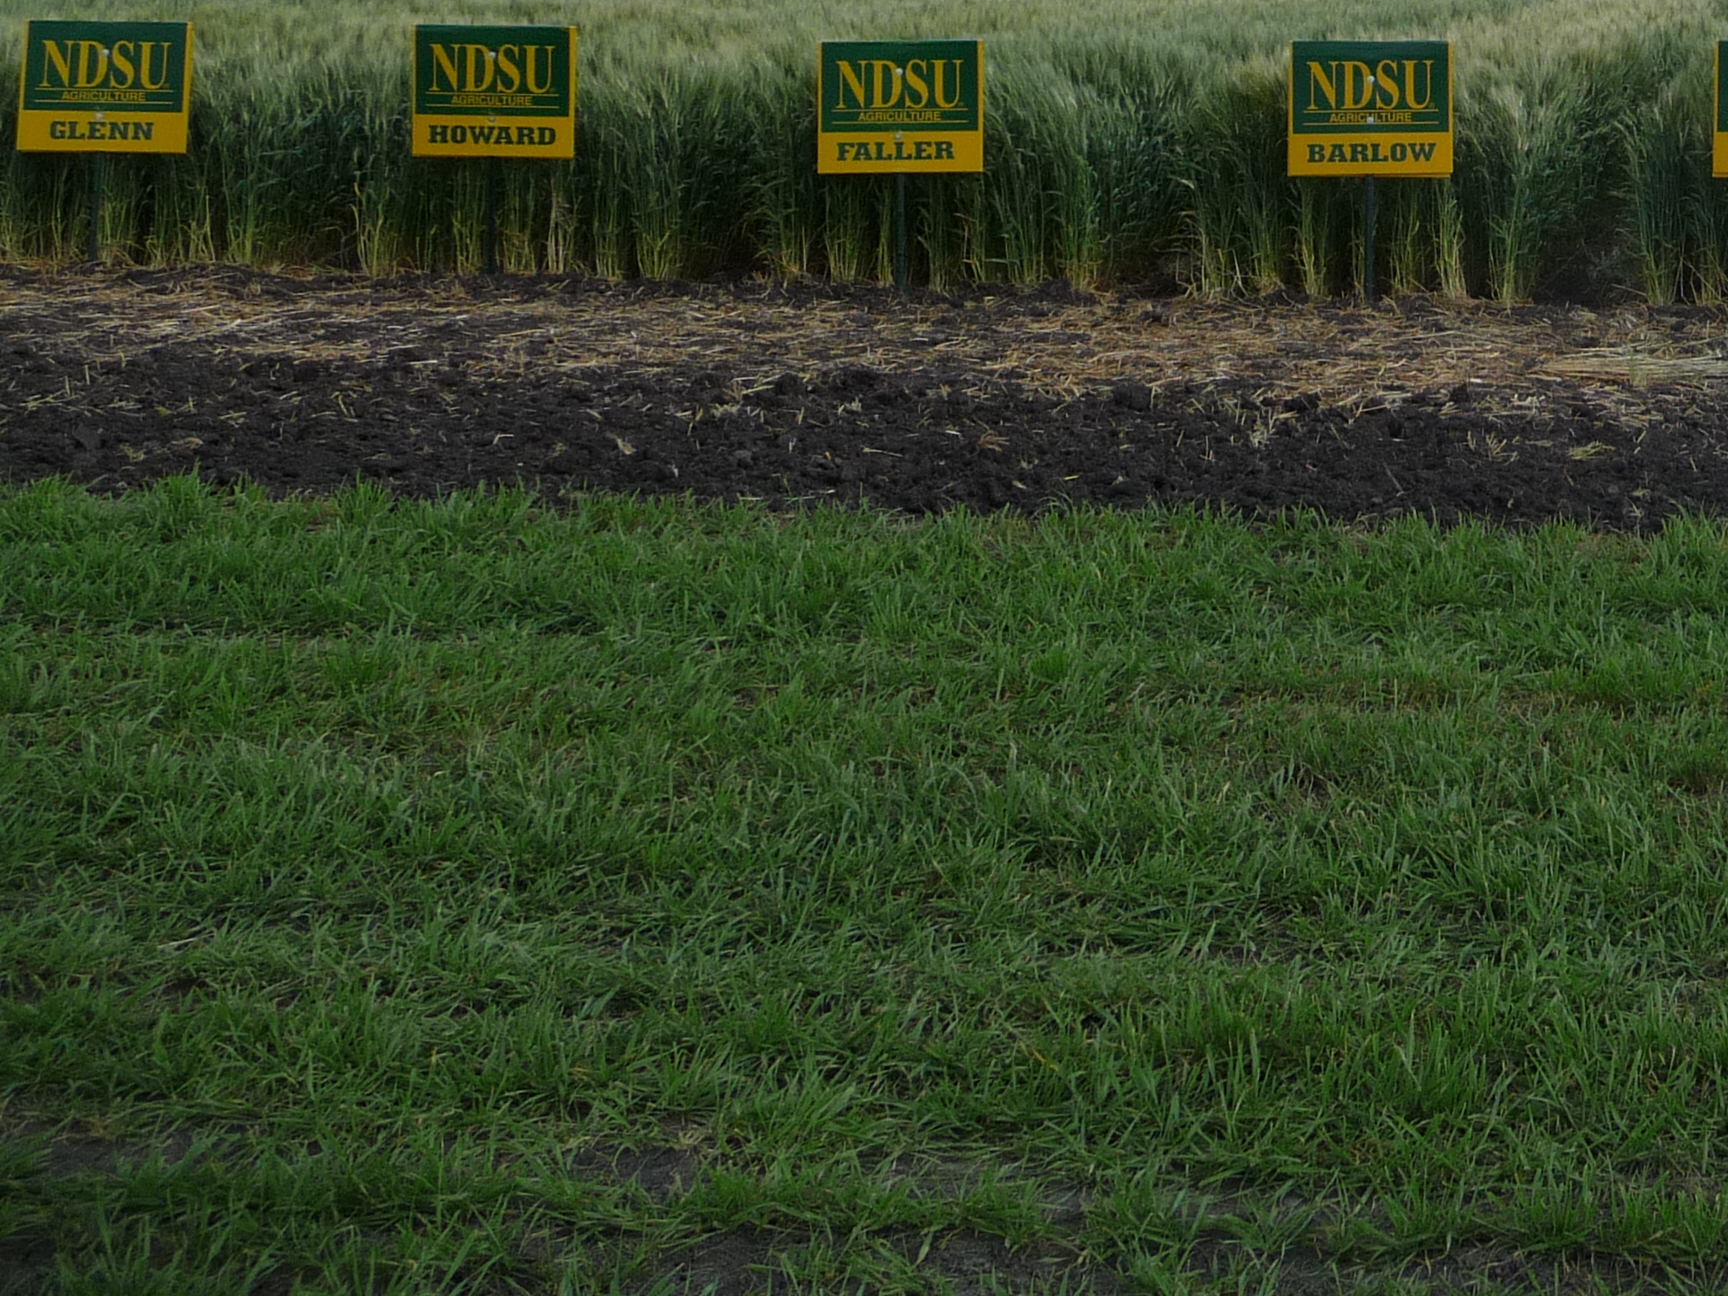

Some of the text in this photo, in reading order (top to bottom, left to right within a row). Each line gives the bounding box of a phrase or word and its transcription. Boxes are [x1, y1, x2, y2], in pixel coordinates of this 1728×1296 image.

[39, 39, 171, 89] NDSU
[429, 43, 556, 94] NDSU
[835, 58, 963, 108] NDSU
[1306, 59, 1435, 110] NDSU
[62, 91, 146, 102] AGRICULTURE
[451, 95, 532, 106] AGRICULTURE
[858, 111, 941, 122] AGRICULTURE
[49, 121, 153, 141] GLENN
[428, 126, 556, 145] HOWARD
[837, 141, 954, 161] FALLER
[1307, 142, 1435, 163] BARLOW
